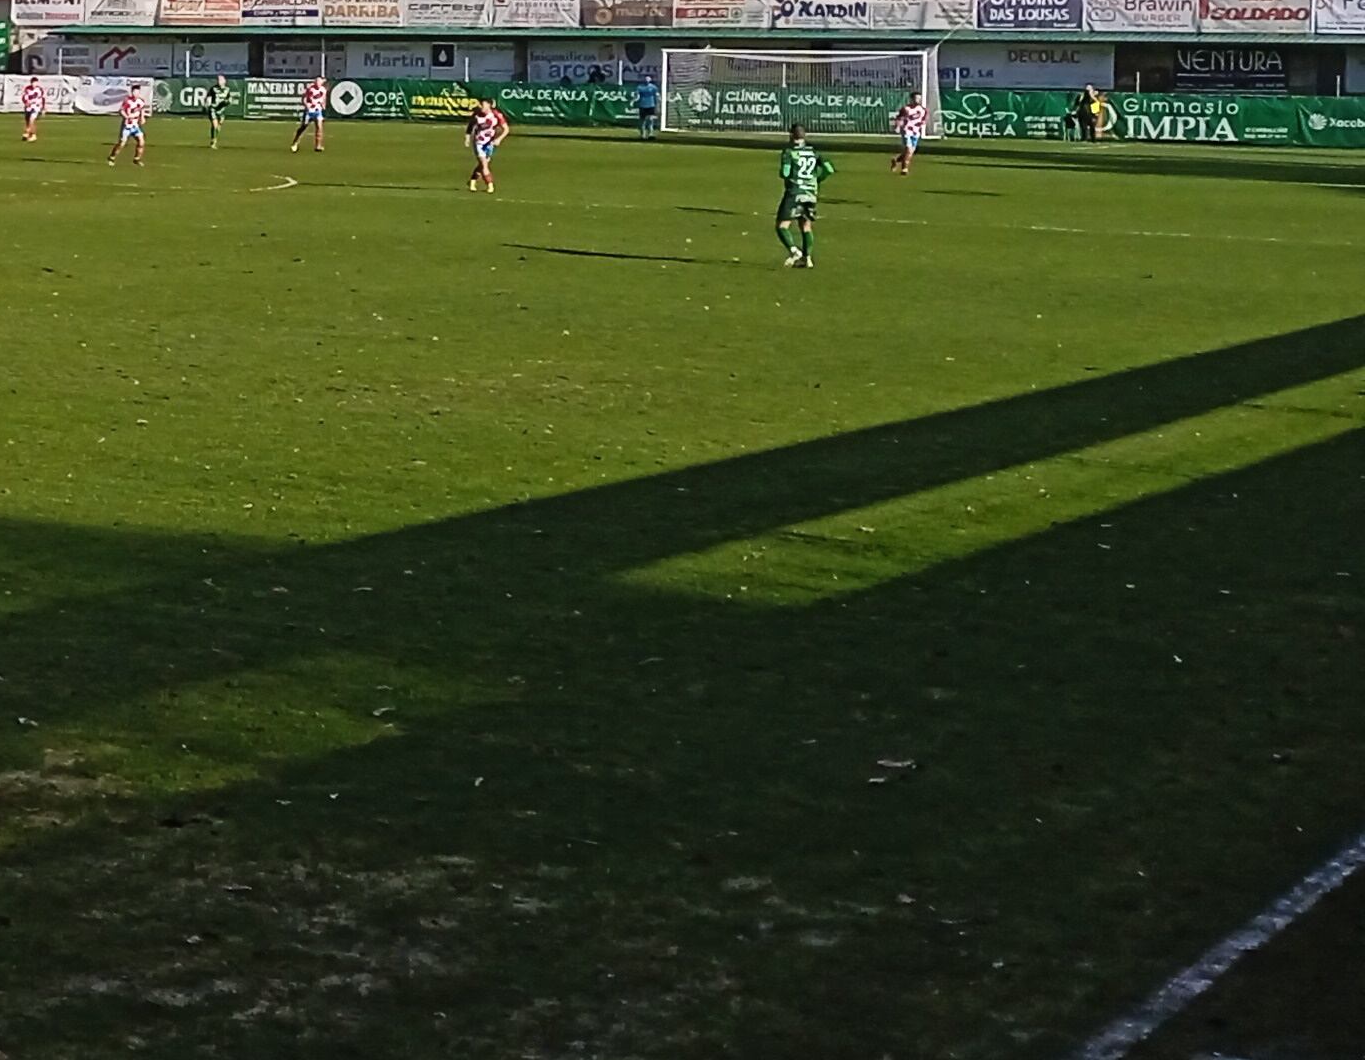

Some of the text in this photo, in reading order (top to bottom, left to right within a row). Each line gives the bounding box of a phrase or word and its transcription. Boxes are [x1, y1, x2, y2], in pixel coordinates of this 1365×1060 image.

[686, 9, 728, 18] SPAR
[989, 8, 1015, 21] DAS
[1017, 8, 1070, 21] LOUSAS
[1133, 13, 1181, 23] BURGER
[1007, 49, 1081, 64] DECOLAC
[1176, 49, 1282, 71] VENTURA
[364, 91, 404, 106] COPE
[537, 89, 552, 101] DE
[725, 88, 777, 103] CLÍNICA
[788, 94, 825, 106] CASAL
[827, 95, 844, 107] DE
[720, 103, 782, 116] ALAMEDA
[797, 156, 817, 179] 22
